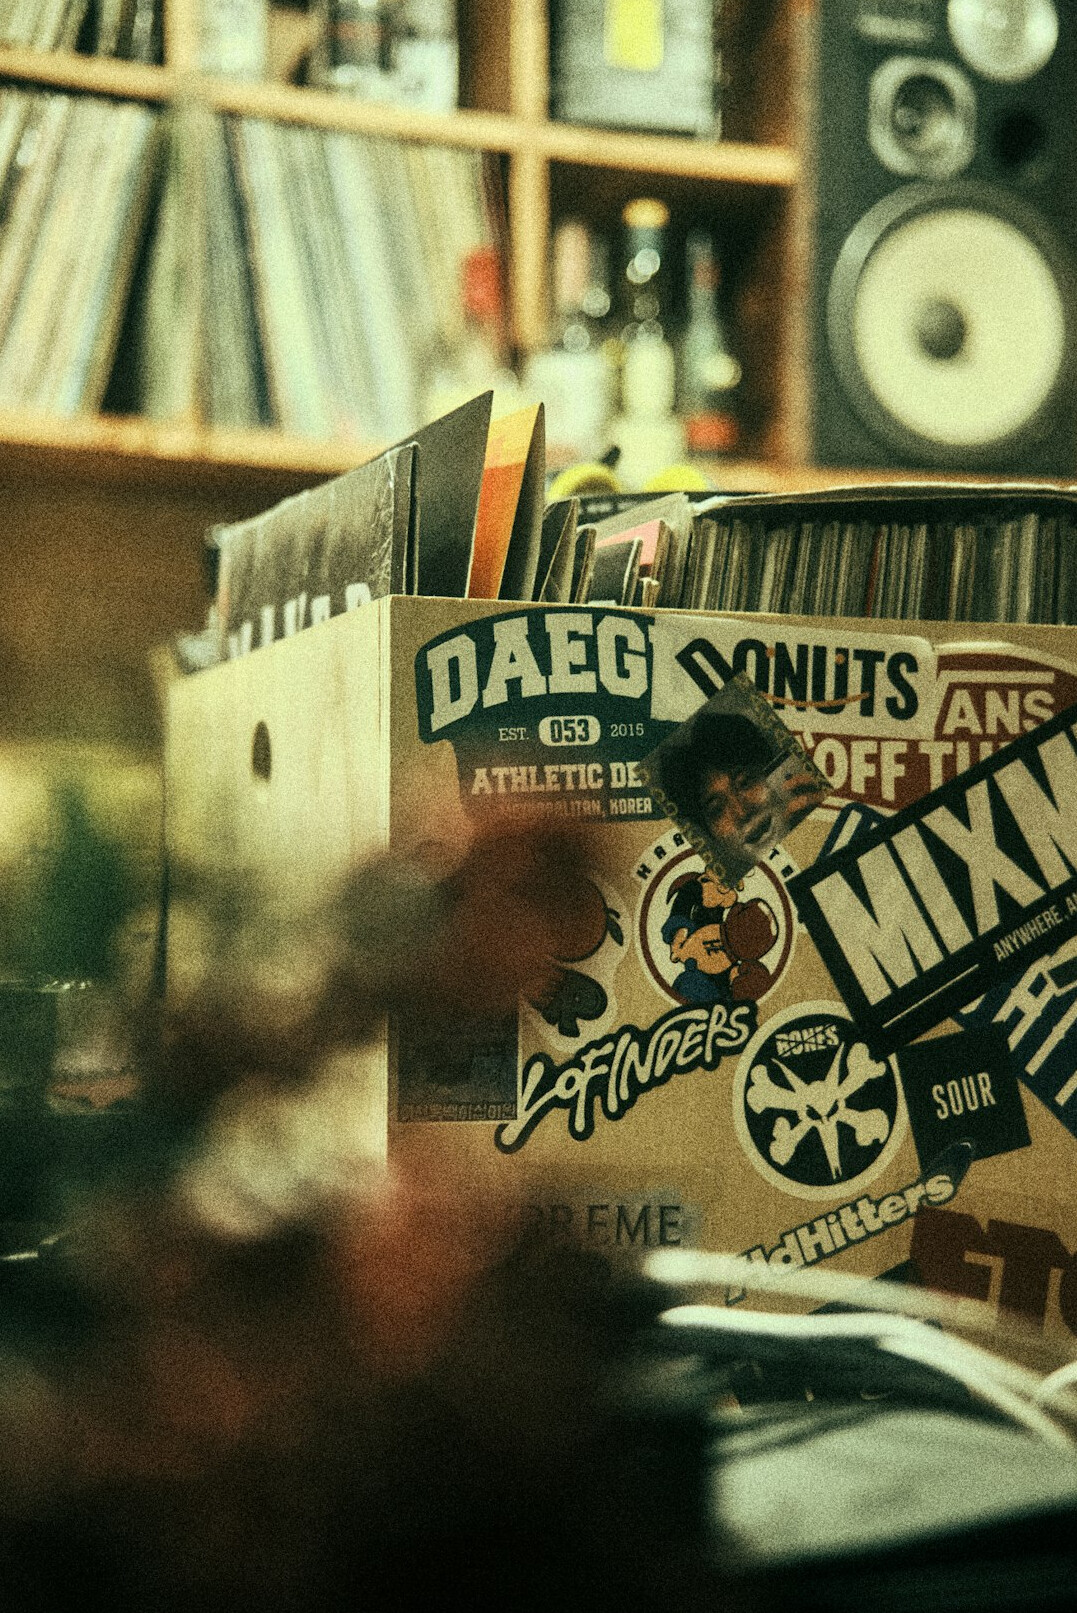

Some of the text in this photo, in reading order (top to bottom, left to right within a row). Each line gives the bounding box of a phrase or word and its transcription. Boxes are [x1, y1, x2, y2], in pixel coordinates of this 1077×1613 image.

[426, 613, 653, 732] DAEG
[675, 638, 919, 721] DONUTS
[498, 719, 645, 742] EST. 053 2015
[941, 687, 1055, 735] ANS
[471, 761, 642, 796] ATHLETIC DE
[610, 797, 652, 815] KOREA
[636, 832, 685, 880] HAR
[810, 723, 1077, 1006] MIXM
[775, 1023, 840, 1057] BONES
[931, 1071, 997, 1121] SOUR
[743, 1174, 954, 1266] dHitters
